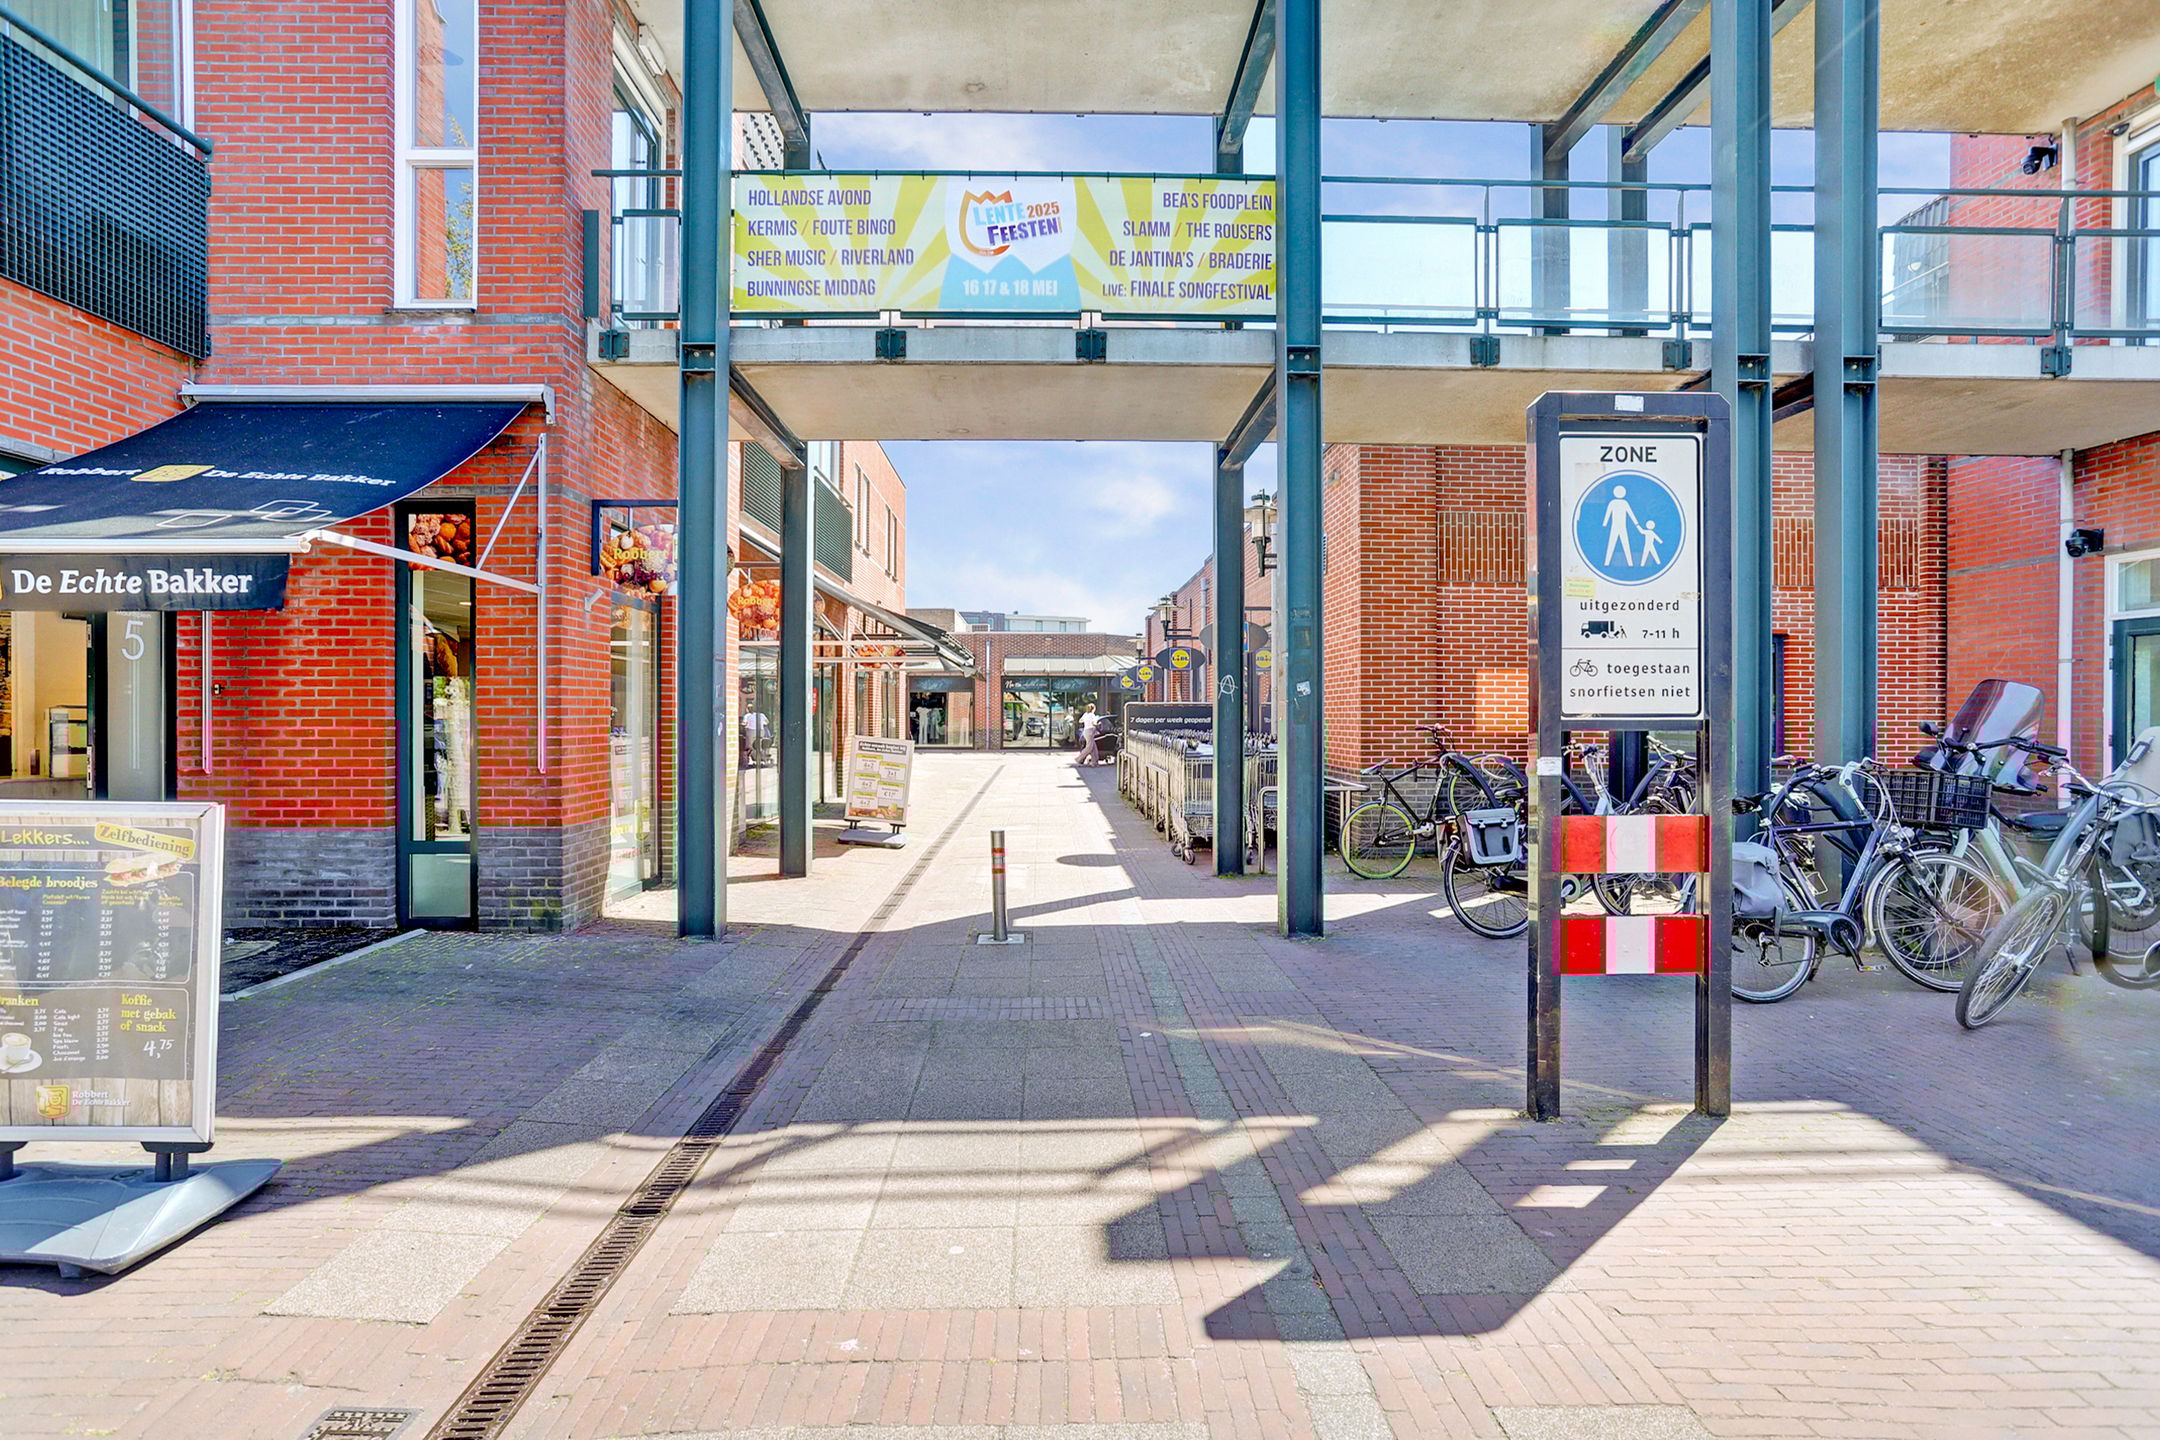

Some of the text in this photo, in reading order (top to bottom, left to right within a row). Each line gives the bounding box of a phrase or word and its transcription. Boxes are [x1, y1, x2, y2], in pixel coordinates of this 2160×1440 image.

[749, 189, 871, 206] HOLLANDSE AVOND
[1163, 192, 1272, 210] BEA'S FOODPLEIN
[972, 201, 1060, 226] LENTE 2025
[748, 220, 797, 236] KERMIS
[813, 219, 853, 235] FOUTE
[857, 219, 896, 235] BINGO
[987, 217, 1059, 245] FEESTEN
[1123, 220, 1170, 237] SLAMM
[1186, 222, 1210, 238] THE
[1214, 223, 1272, 241] ROUSERS
[747, 250, 782, 266] SHER
[785, 249, 826, 266] MUSIC
[841, 248, 914, 265] RIVERLAND
[1110, 250, 1125, 266] DE
[1129, 251, 1194, 268] JANTINA'S
[1209, 252, 1272, 270] BRADERIE
[747, 279, 875, 297] BUNNINGSE MIDDAG
[963, 280, 1058, 296] 16 17 & 18 MEI
[1102, 280, 1272, 300] LIVE: FINALE SONGFESTIVAL
[1600, 446, 1657, 463] ZONE
[202, 470, 396, 486] De Echte Bakker
[613, 548, 668, 559] Robbert
[11, 567, 252, 593] De Echte Bakker
[1580, 599, 1680, 614] uitgezonderd
[121, 619, 144, 660] 5
[1642, 628, 1680, 639] 7-11 h
[1607, 663, 1690, 677] toegestaan
[1569, 685, 1690, 697] snorfietsen niet
[100, 825, 190, 858] Zelfbediening
[46, 875, 98, 889] broodjes
[122, 994, 153, 1006] Koffie
[121, 1008, 177, 1022] met gebak
[120, 1020, 167, 1032] of snack
